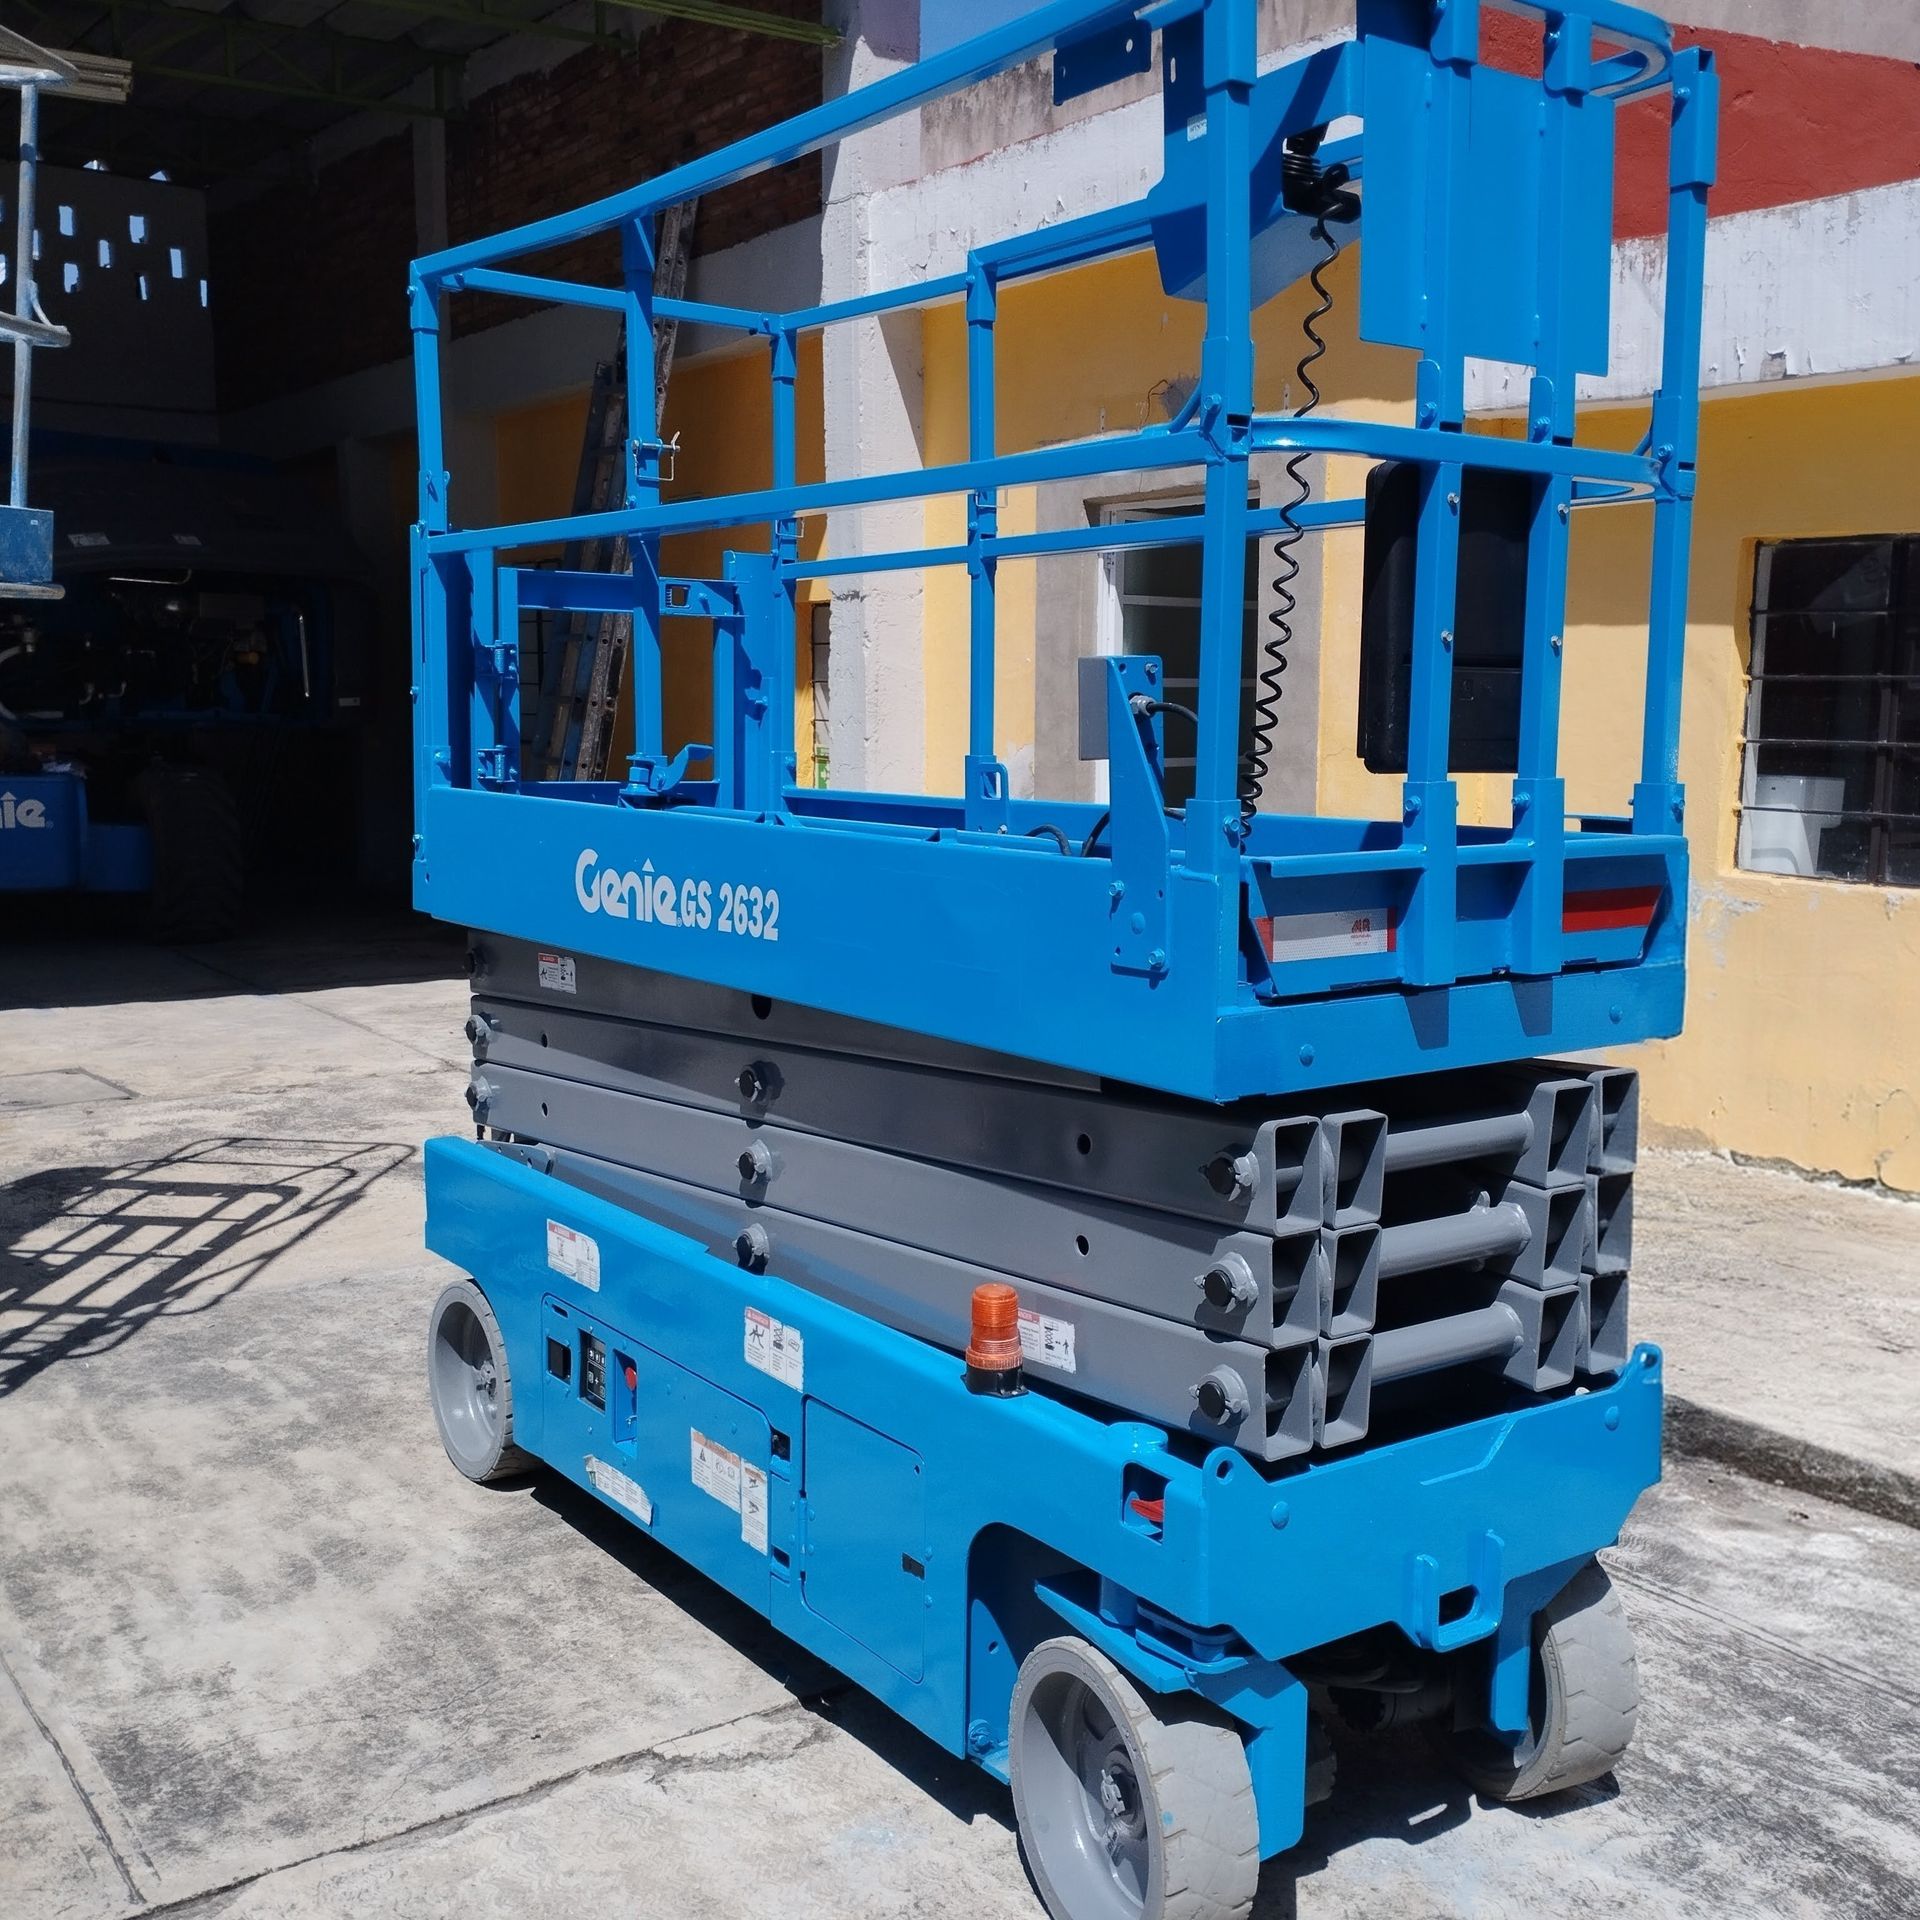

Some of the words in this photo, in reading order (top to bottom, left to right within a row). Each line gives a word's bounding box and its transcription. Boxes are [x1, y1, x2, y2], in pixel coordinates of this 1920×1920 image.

[574, 848, 677, 926] Genie
[681, 878, 712, 930] GS
[718, 882, 779, 941] 2632
